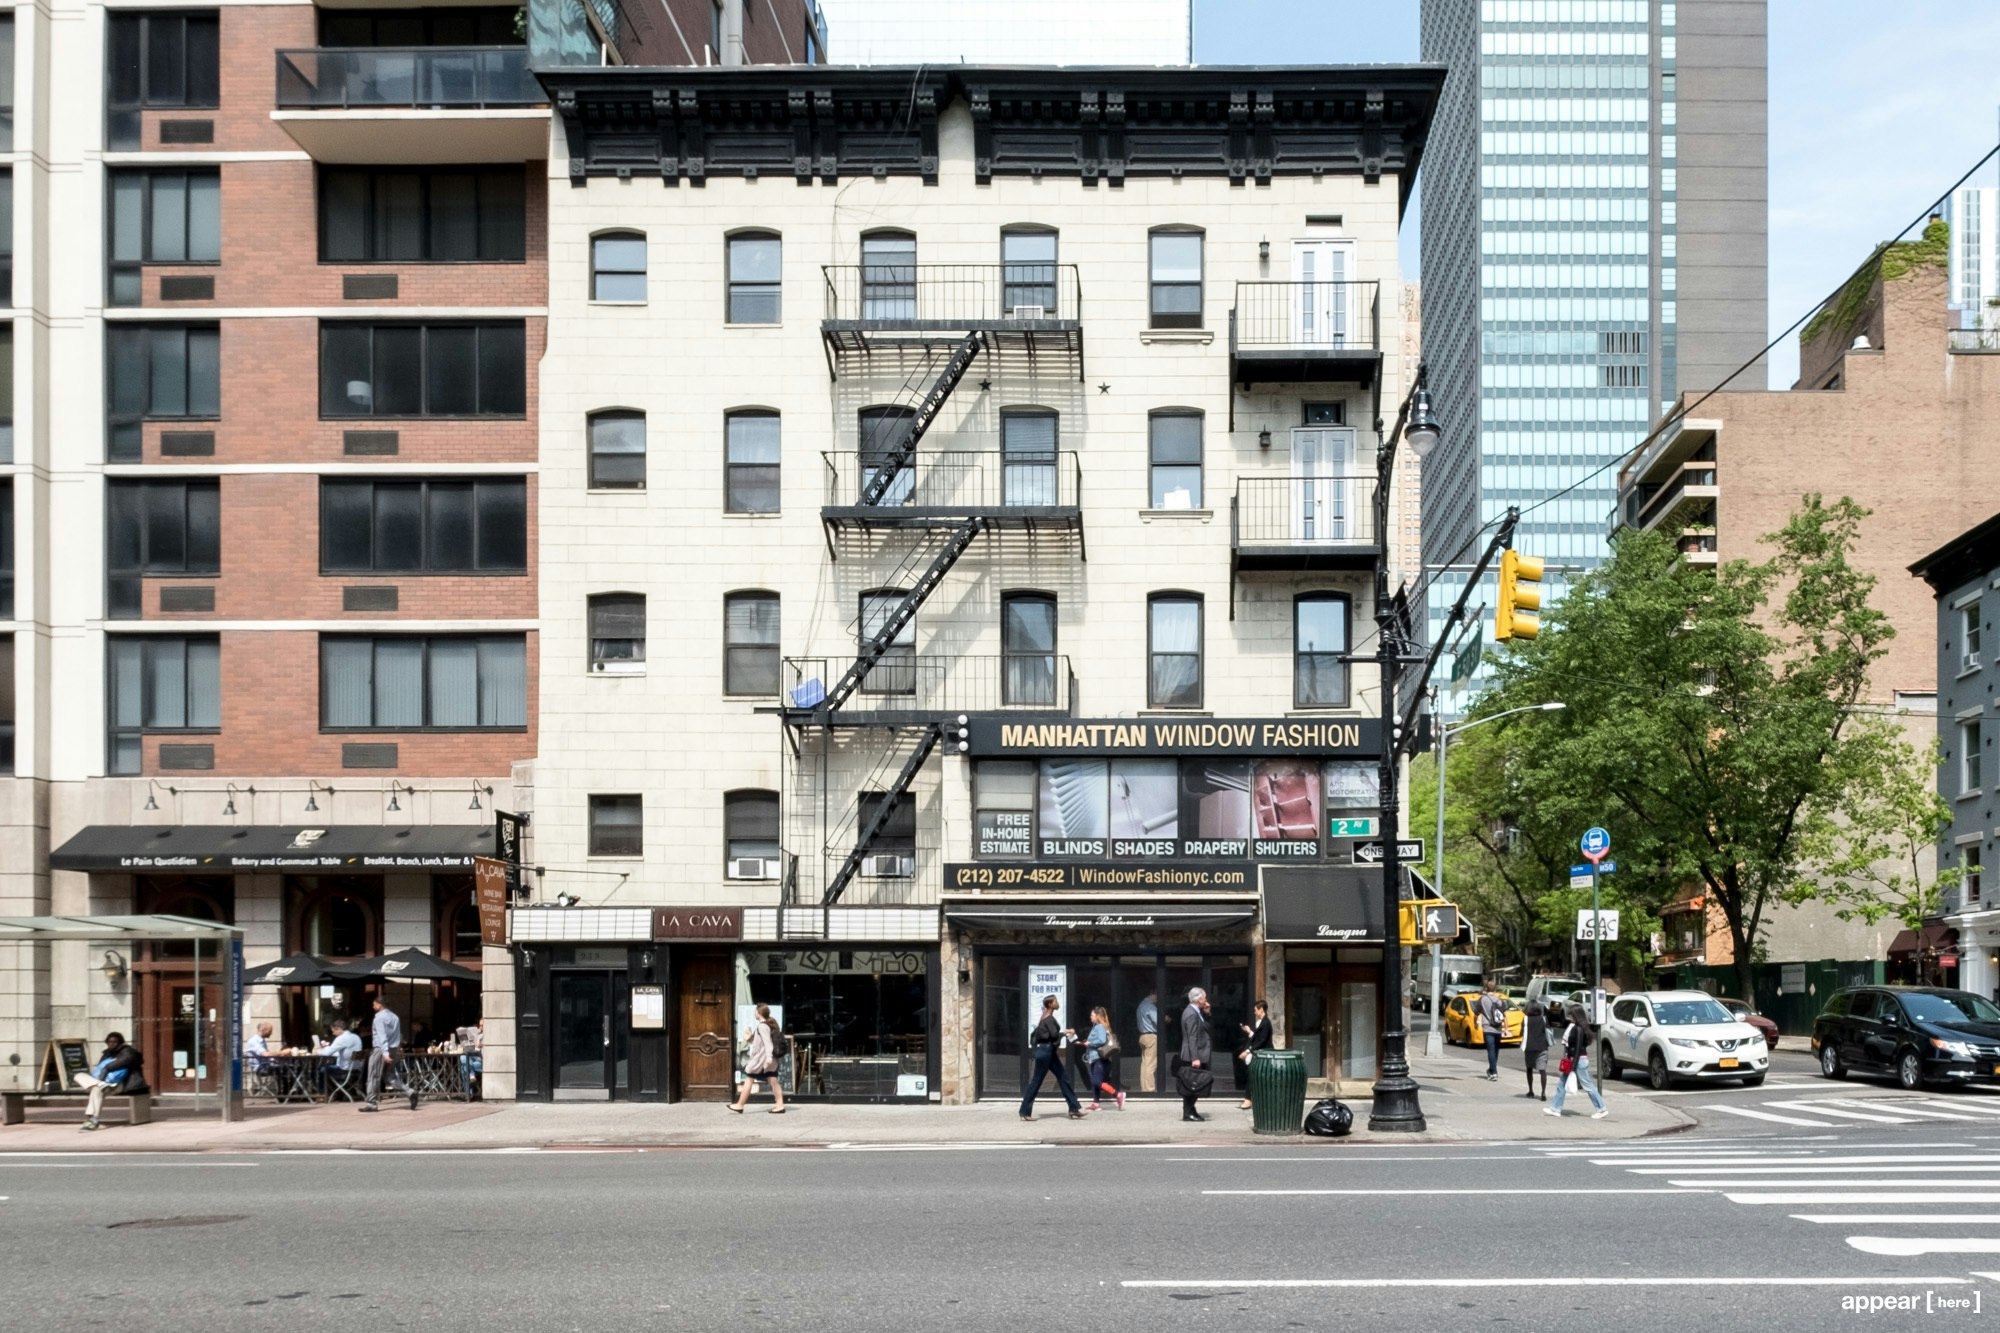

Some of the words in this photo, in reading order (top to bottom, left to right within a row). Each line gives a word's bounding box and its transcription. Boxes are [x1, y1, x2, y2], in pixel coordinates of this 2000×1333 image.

[1002, 724, 1147, 747] MANHATTAN
[1154, 724, 1256, 747] WINDOW
[1263, 724, 1360, 747] FASHION
[997, 814, 1030, 825] FREE
[982, 828, 1030, 839] IN-HOME
[1338, 821, 1348, 835] 2
[1353, 820, 1364, 828] AV
[980, 841, 1030, 853] ESTIMATE
[1043, 841, 1104, 854] BLINDS
[1115, 841, 1175, 855] SHADES
[1185, 841, 1246, 855] DRAPERY
[1255, 841, 1317, 855] SHUTTERS
[1363, 847, 1383, 856] ONE
[1397, 846, 1414, 855] AY
[121, 857, 131, 866] Le
[133, 857, 152, 866] Pain
[154, 857, 197, 867] Quotidien
[232, 857, 259, 867] Bakery
[260, 857, 276, 866] and
[276, 857, 318, 866] Communal
[320, 857, 341, 866] Table
[364, 856, 395, 866] Breakfast,
[396, 856, 421, 866] Brunch,
[422, 856, 443, 866] Lunch,
[443, 856, 461, 866] Dinner
[463, 856, 471, 866] &
[475, 863, 485, 876] LA
[956, 868, 993, 886] (212)
[997, 868, 1064, 884] 207-4522
[1080, 868, 1244, 886] WindowFashionyc.com
[689, 915, 732, 926] CAVA
[1316, 924, 1367, 940] Lasagna
[1037, 974, 1058, 982] STORE
